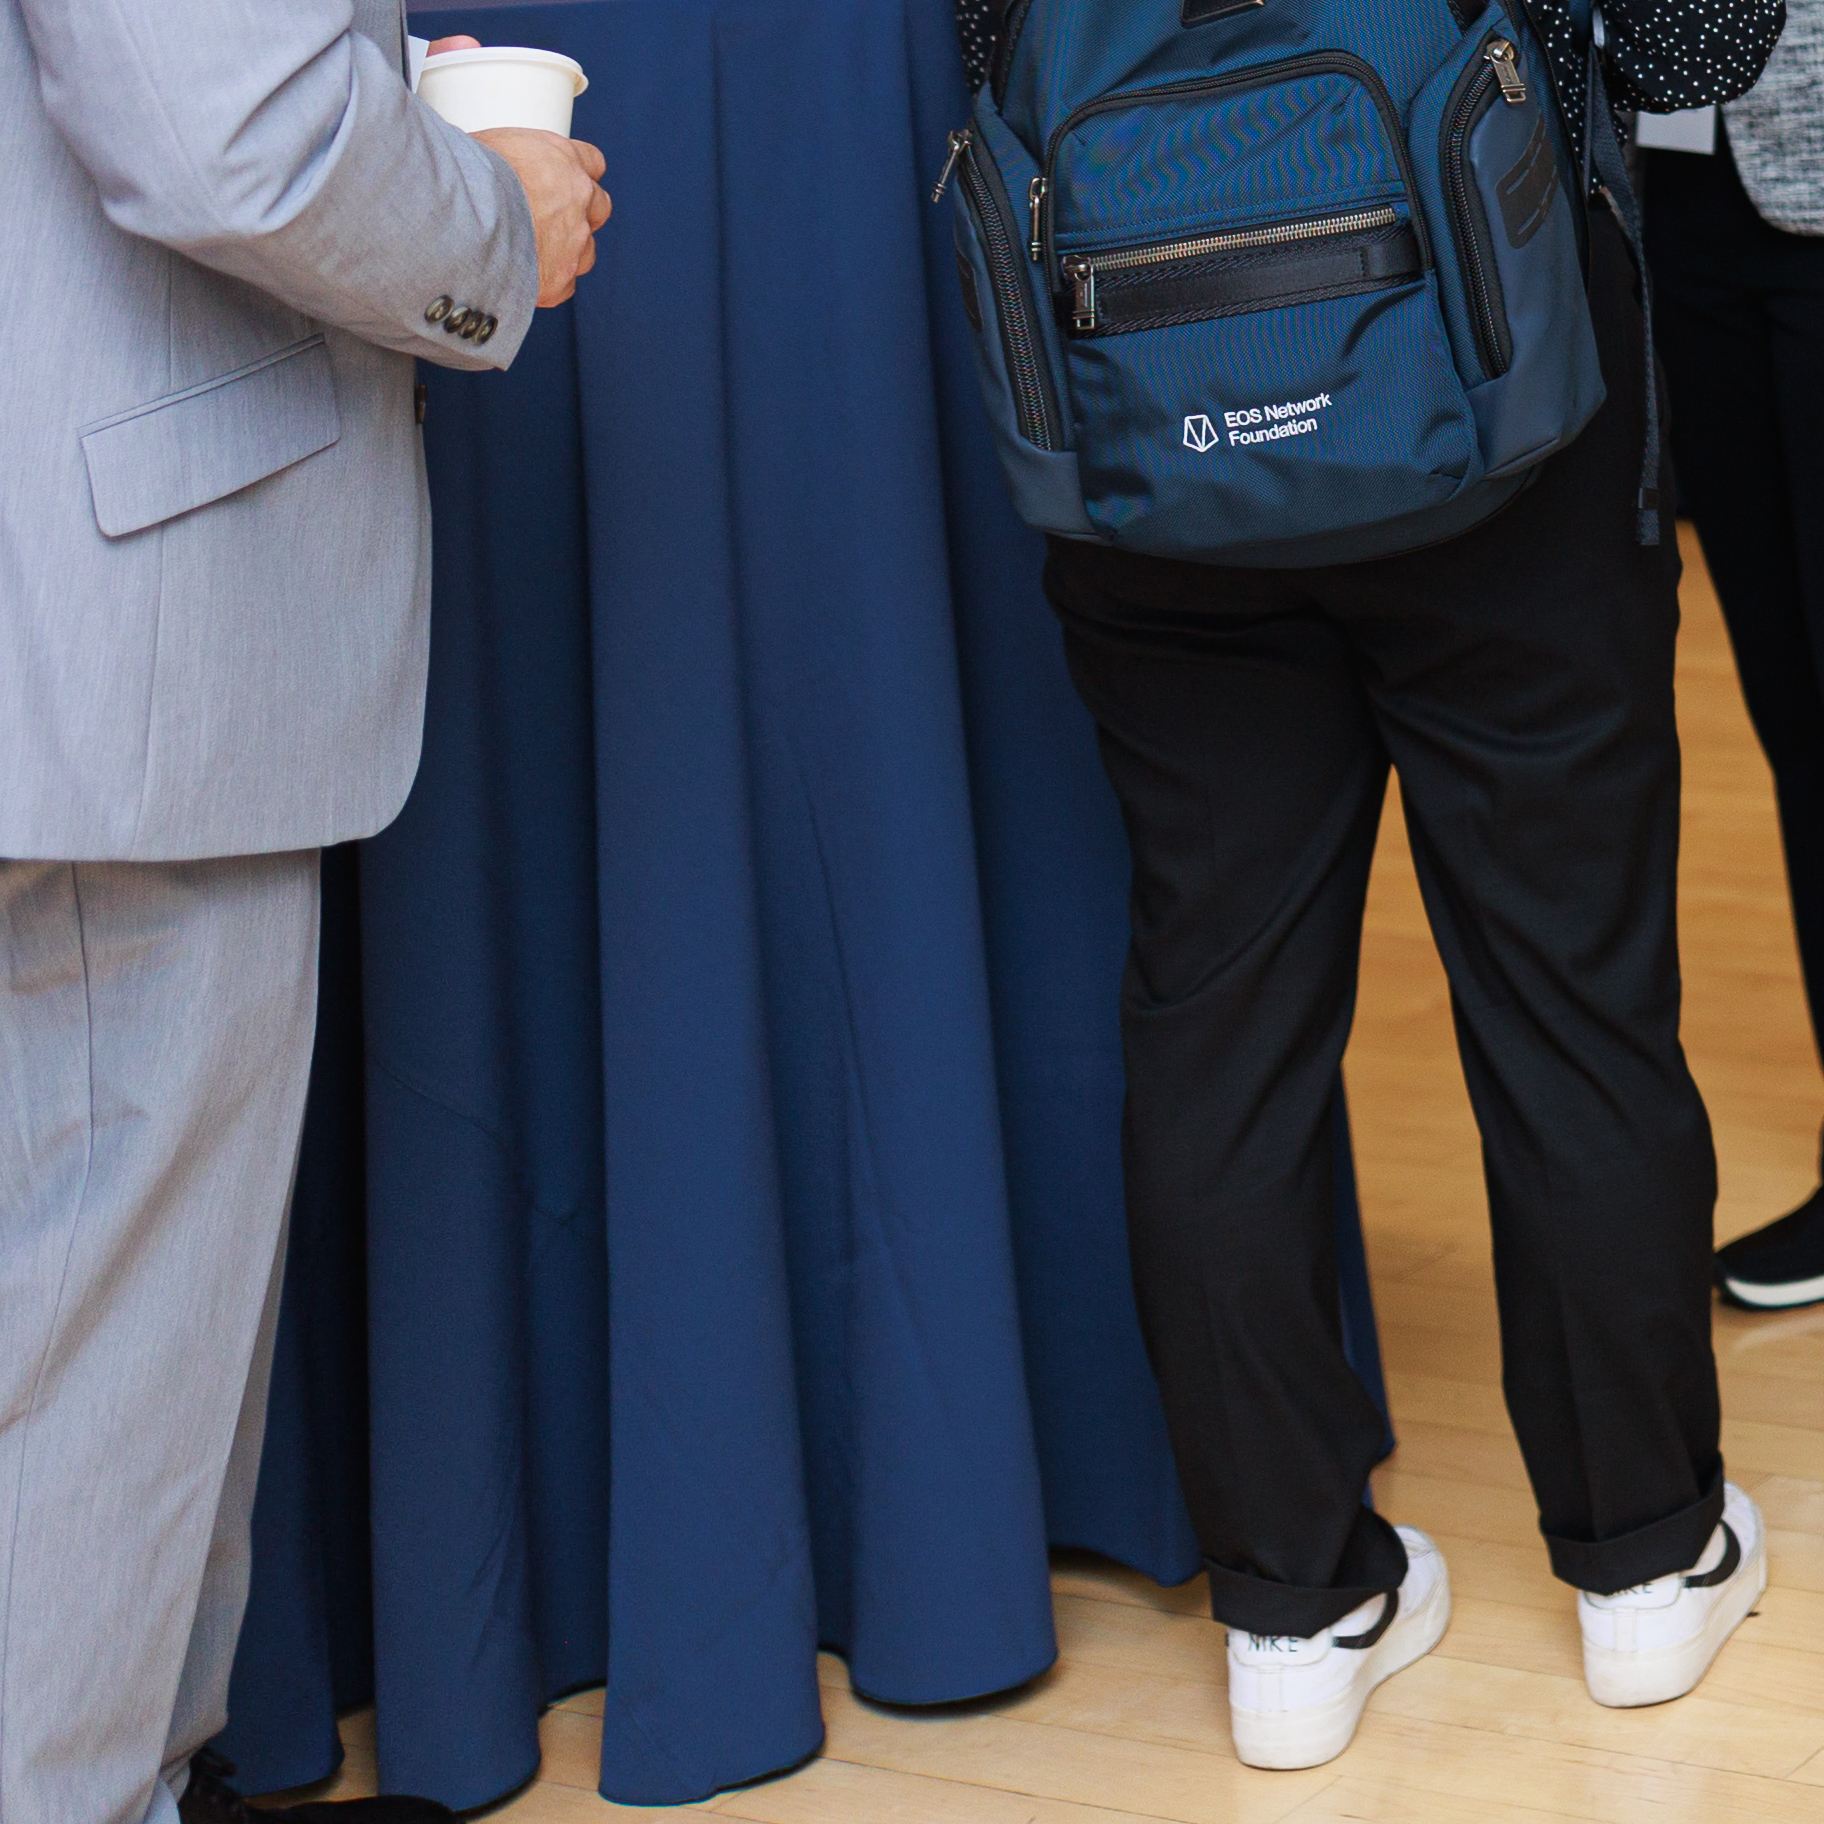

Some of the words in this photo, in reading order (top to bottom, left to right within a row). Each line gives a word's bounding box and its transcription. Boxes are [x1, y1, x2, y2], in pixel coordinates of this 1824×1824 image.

[1224, 408, 1263, 427] EOS
[1264, 392, 1332, 421] Network
[1228, 418, 1318, 446] Foundation
[1248, 1632, 1298, 1653] NIKE
